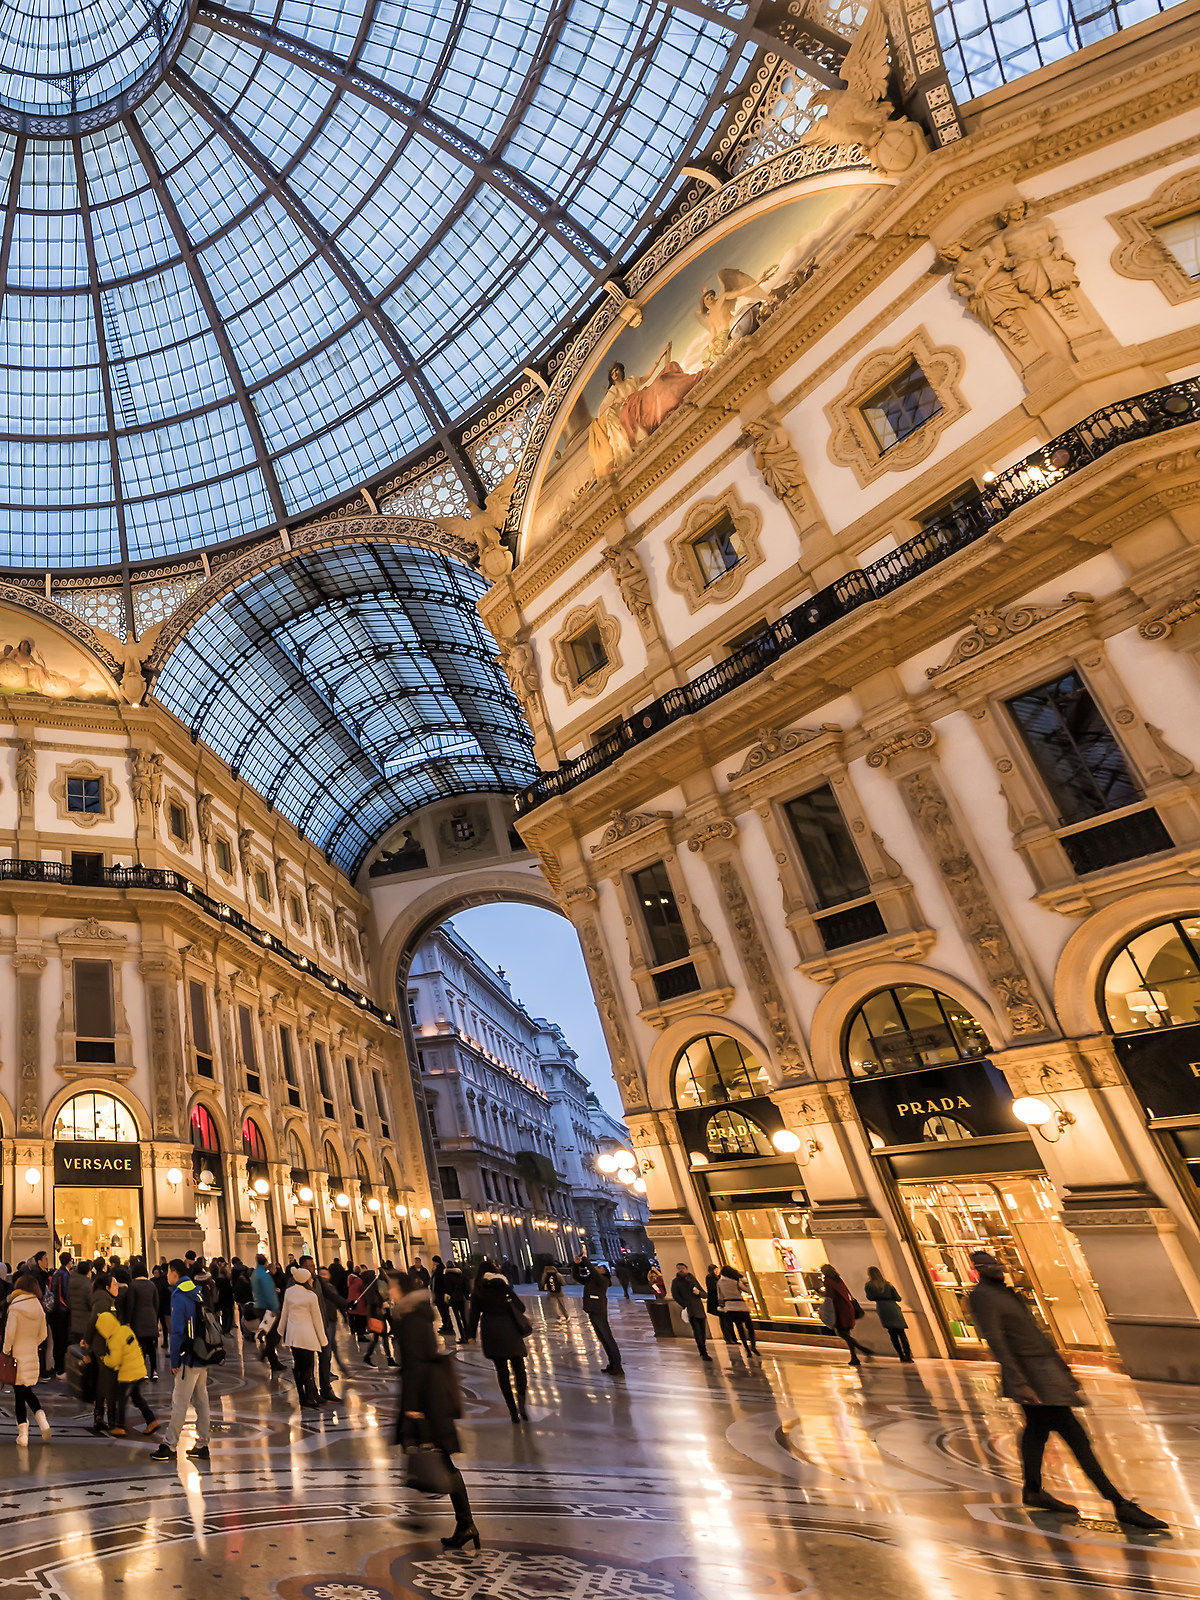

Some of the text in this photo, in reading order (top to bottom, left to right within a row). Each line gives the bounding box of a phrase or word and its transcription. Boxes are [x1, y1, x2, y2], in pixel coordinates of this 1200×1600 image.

[896, 1095, 972, 1117] PRADA
[707, 1123, 759, 1140] PRADA
[63, 1157, 132, 1170] VERSACE
